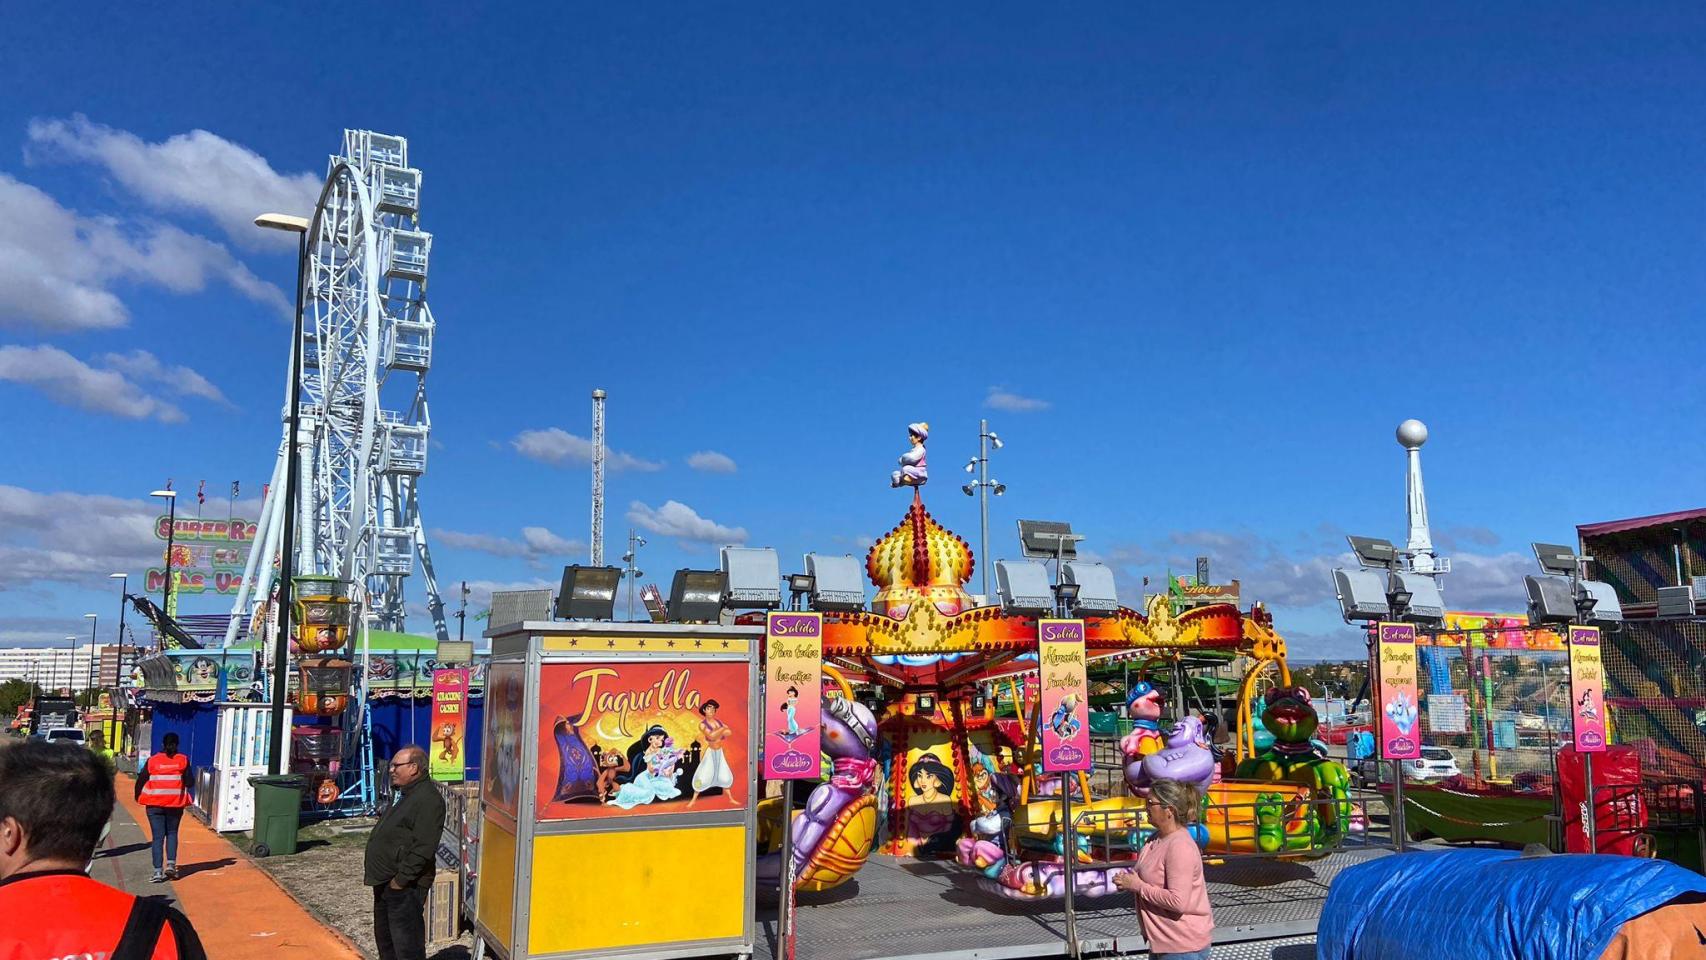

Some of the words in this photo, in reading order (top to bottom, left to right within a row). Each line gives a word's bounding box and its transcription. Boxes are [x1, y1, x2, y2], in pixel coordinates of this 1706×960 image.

[774, 618, 816, 635] Salida
[1045, 626, 1079, 640] Salida
[1383, 627, 1412, 640] Entrada
[572, 668, 700, 737] Taquilla
